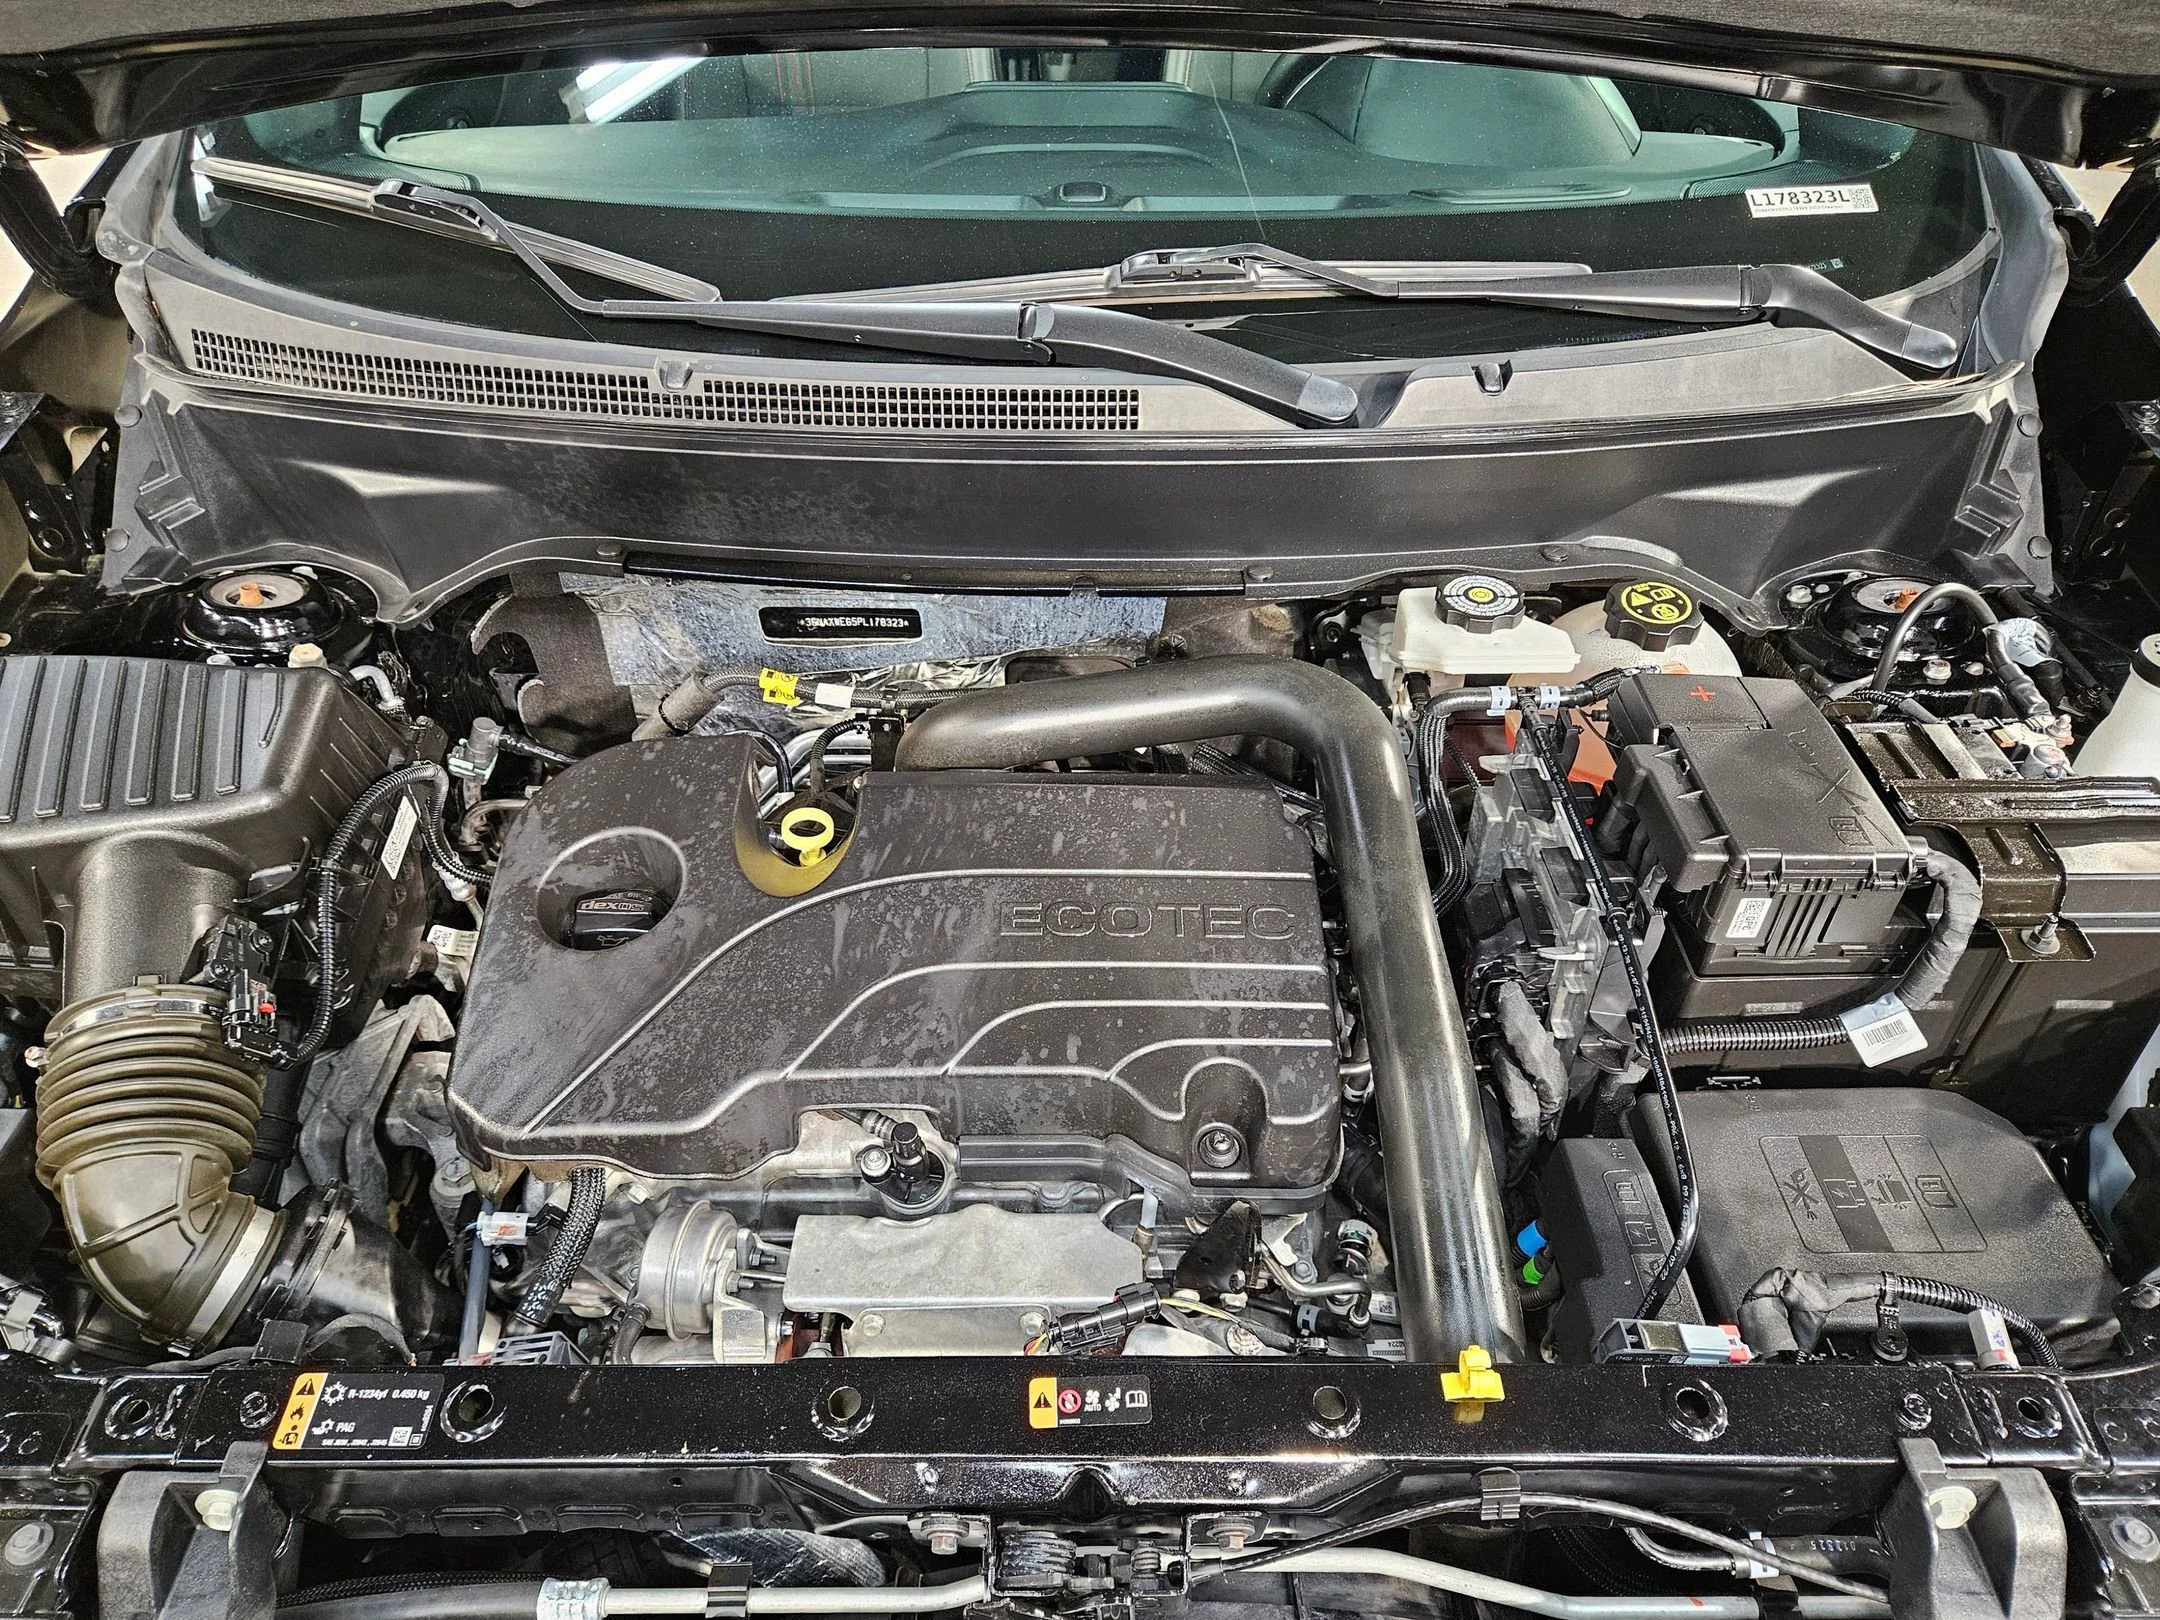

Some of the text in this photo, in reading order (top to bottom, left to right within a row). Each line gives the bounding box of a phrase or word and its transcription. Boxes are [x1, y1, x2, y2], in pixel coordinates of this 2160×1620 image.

[1750, 189, 1851, 207] L178323L
[581, 900, 645, 912] dexos
[1000, 901, 1296, 941] ECOTEC
[347, 1389, 431, 1400] R-1234yf 0.450 kg
[1084, 1403, 1102, 1412] AUTO
[335, 1422, 356, 1433] PAG
